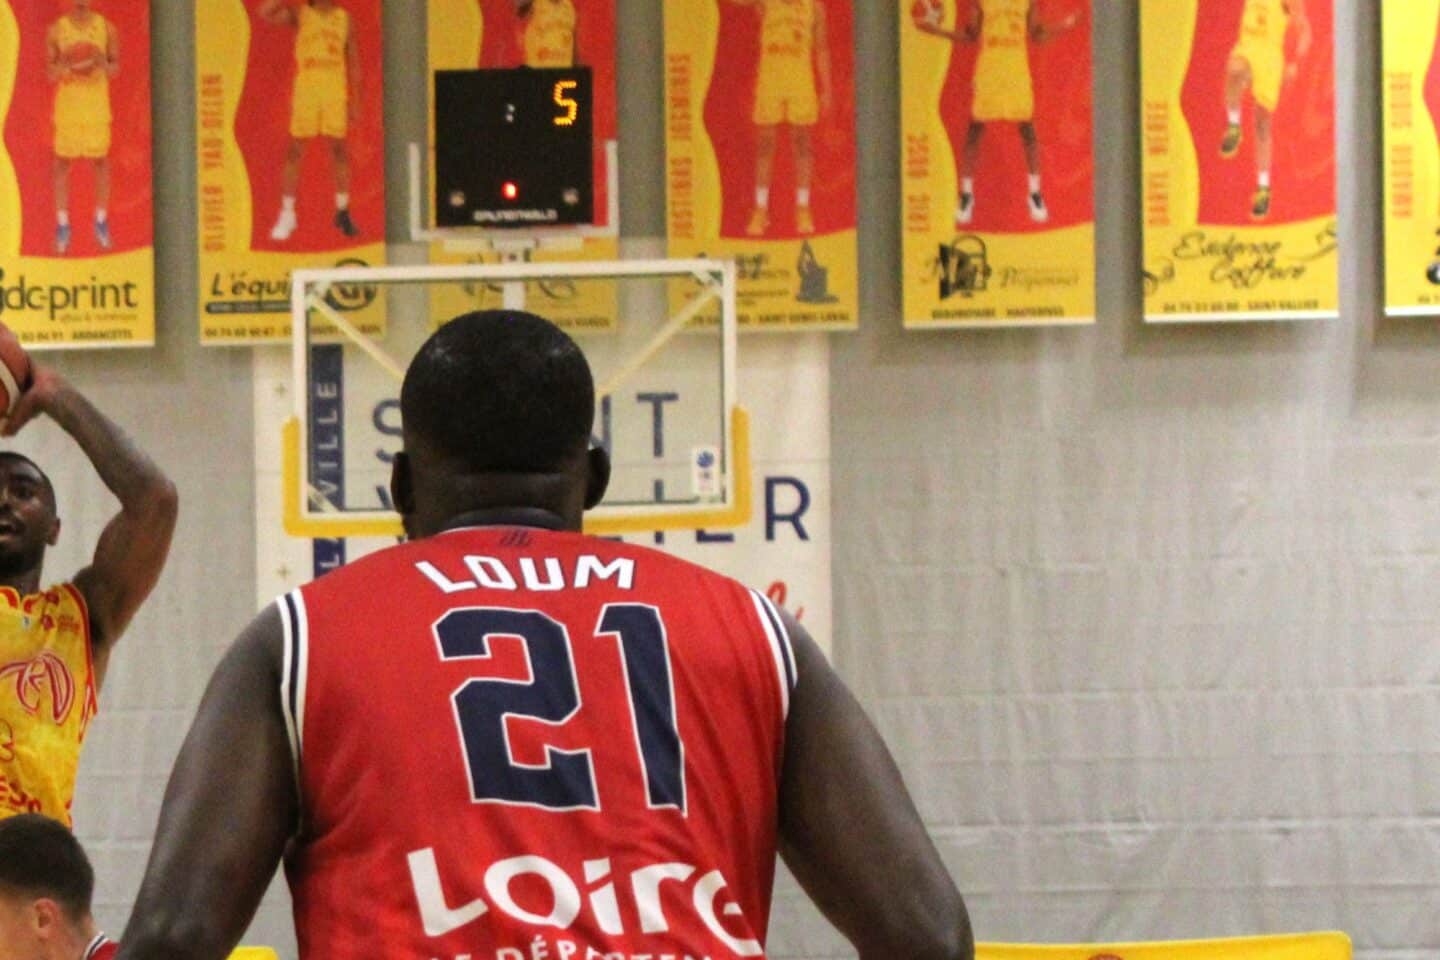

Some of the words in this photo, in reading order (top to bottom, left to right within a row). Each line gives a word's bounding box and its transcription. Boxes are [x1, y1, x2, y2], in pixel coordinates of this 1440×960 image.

[553, 80, 577, 125] 5
[415, 554, 636, 594] LOUM
[432, 602, 688, 819] 21
[406, 847, 764, 958] Loire
